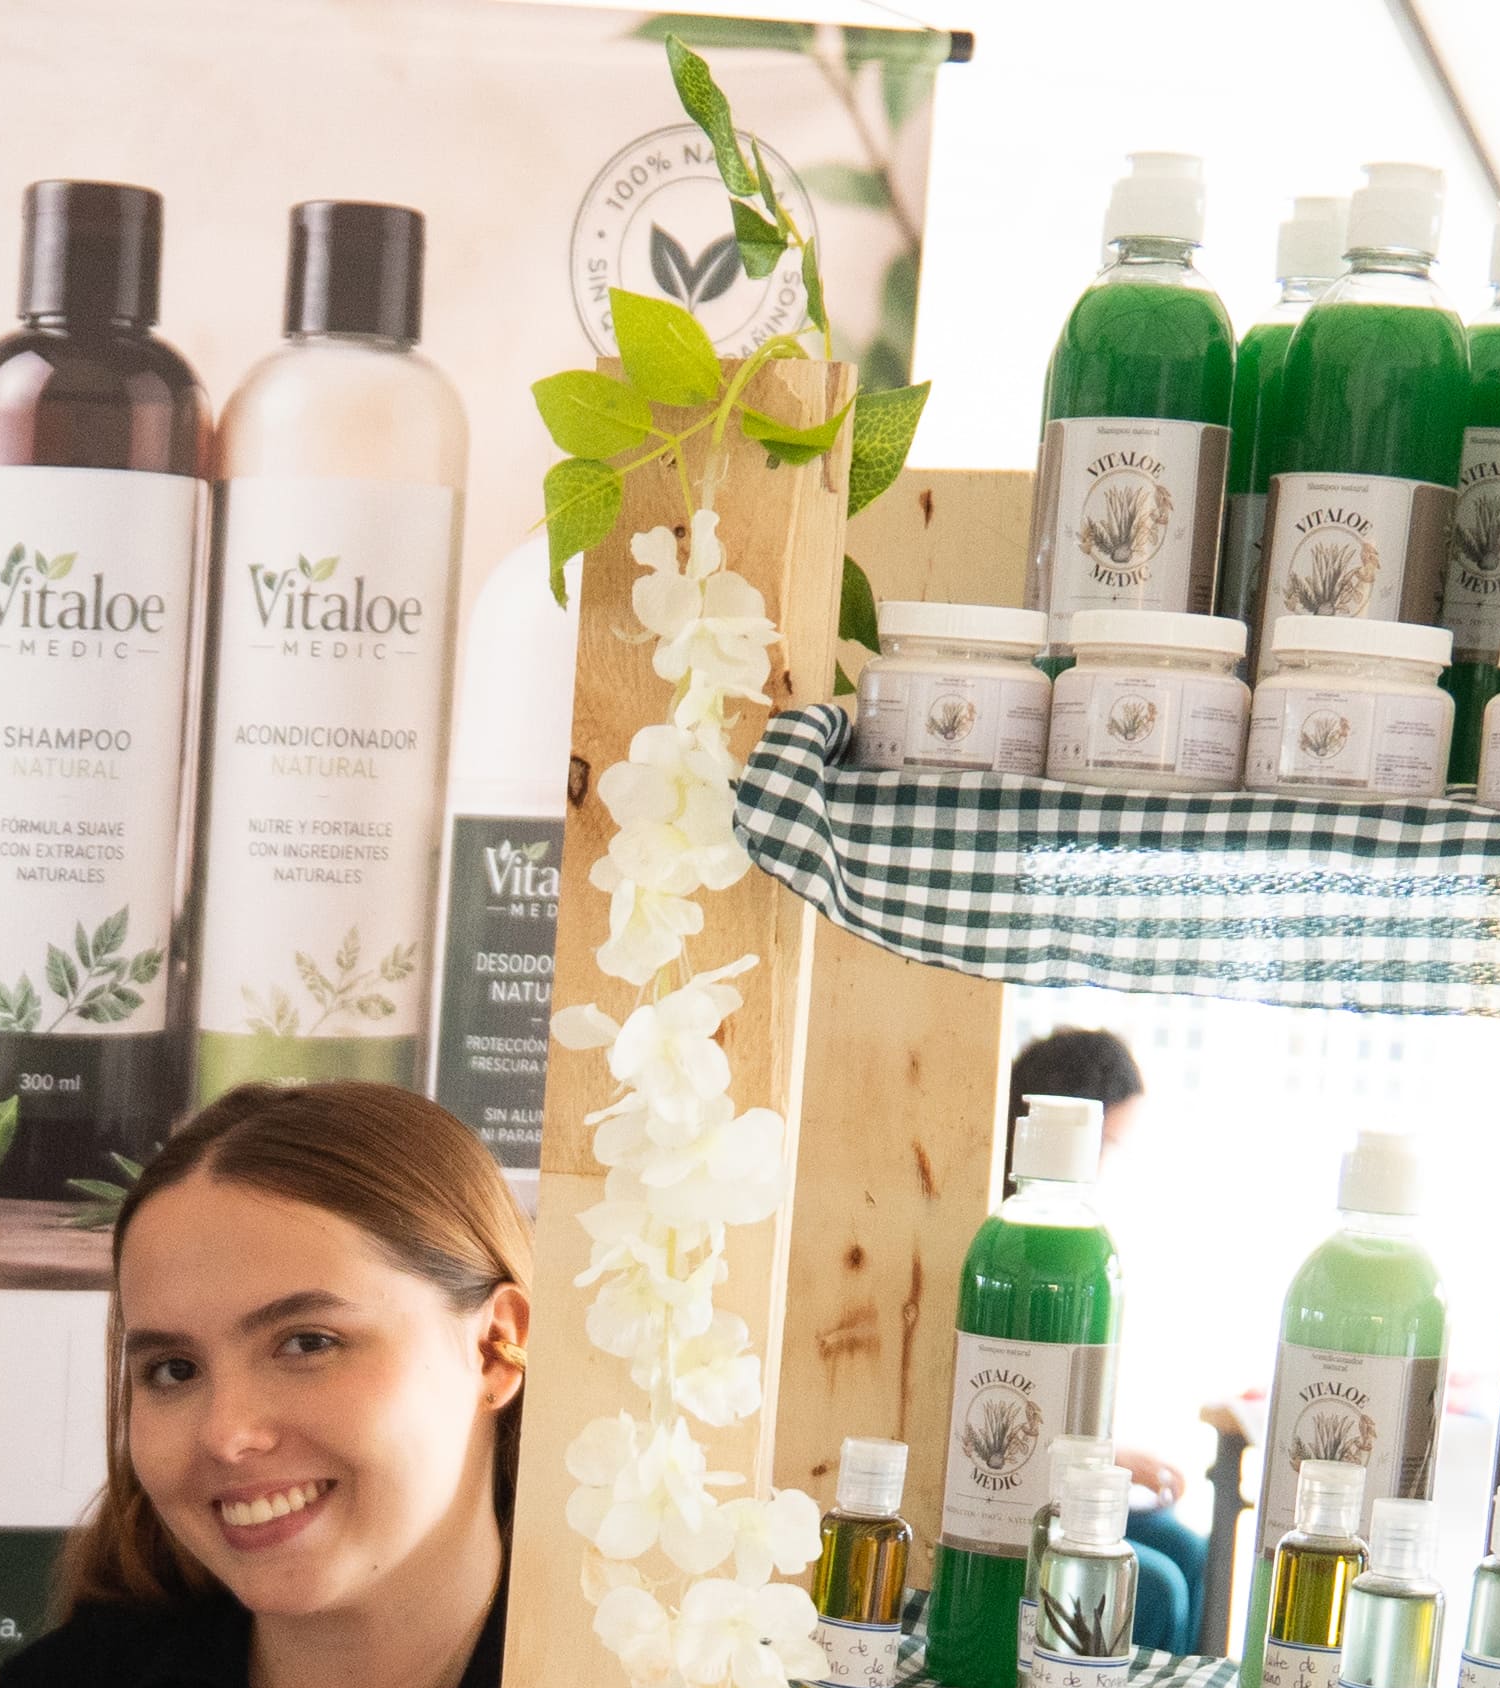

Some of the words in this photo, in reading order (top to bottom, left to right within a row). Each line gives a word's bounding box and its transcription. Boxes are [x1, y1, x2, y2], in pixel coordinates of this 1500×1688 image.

[722, 269, 802, 358] AÑINOS
[1086, 451, 1165, 479] VITALOE
[1294, 507, 1374, 537] VITALOE
[1089, 564, 1153, 588] MEDIC
[248, 564, 422, 635] Vitaloe
[19, 640, 128, 659] MEDIC
[283, 640, 386, 660] MEDIC
[3, 726, 132, 751] SHAMPOO
[235, 724, 418, 750] ACONDICIONADOR
[12, 756, 121, 780] NATURAL
[272, 755, 378, 779] NATURAL
[1, 815, 72, 836] FÓRMULA
[77, 821, 125, 837] SUAVE
[248, 818, 293, 835] NUTRE
[298, 820, 308, 835] Y
[312, 820, 393, 837] FORTALECE
[0, 841, 31, 858] CON
[36, 843, 125, 860] EXTRACTOS
[248, 841, 278, 857] CON
[283, 843, 389, 861] INGREDIENTES
[16, 867, 105, 884] NATURALES
[274, 867, 362, 884] NATURALES
[485, 847, 560, 897] Vita
[510, 902, 558, 918] MED
[477, 951, 555, 974] DESODO
[491, 980, 551, 1003] NATU
[471, 1055, 538, 1073] FRESCURA
[20, 1073, 54, 1091] 300
[59, 1073, 81, 1092] ml
[484, 1107, 507, 1121] SIN
[498, 1127, 542, 1143] PARAB
[969, 1368, 1037, 1396] VITALOE
[1299, 1381, 1371, 1409] VITALOE
[970, 1467, 1024, 1491] MEDIC
